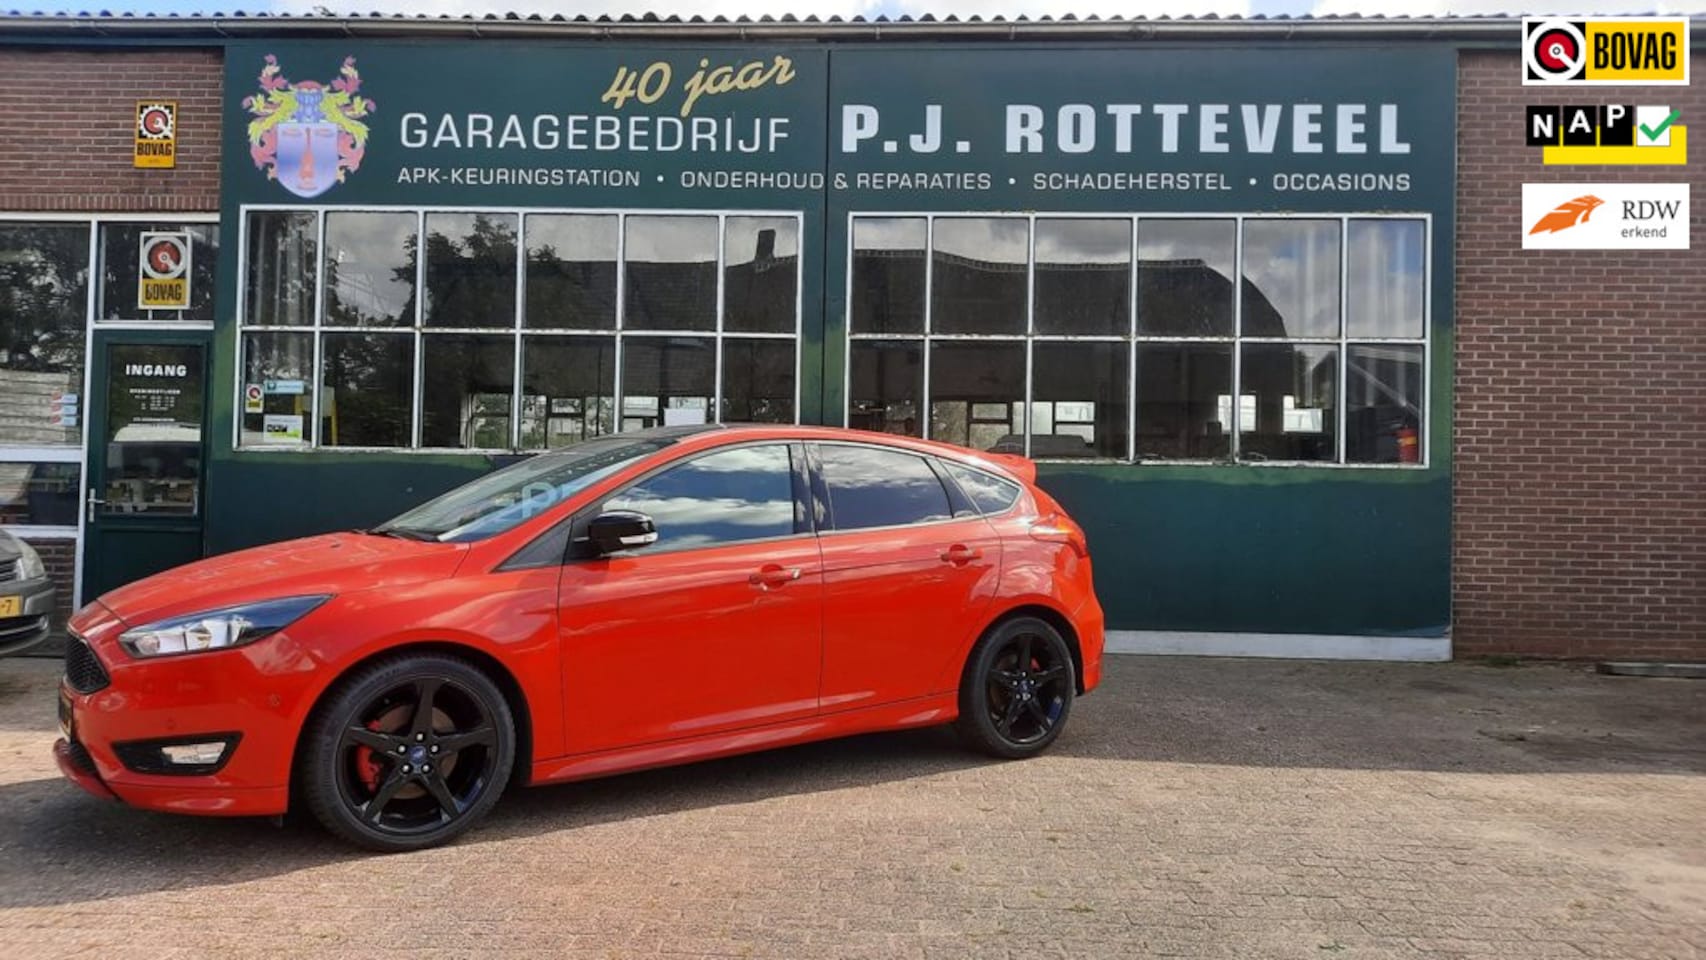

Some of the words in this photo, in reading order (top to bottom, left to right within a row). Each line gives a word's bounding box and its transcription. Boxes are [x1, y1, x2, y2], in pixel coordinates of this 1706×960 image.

[600, 62, 672, 110] 40
[681, 54, 796, 117] jaar
[399, 112, 791, 153] GARAGEBEDRIJF
[841, 104, 971, 153] P.J.
[1005, 104, 1412, 154] ROTTEVEEL
[136, 142, 173, 157] BOVAG
[397, 166, 641, 187] APK-KEURINGSTATION
[680, 170, 825, 189] ONDERHOUD
[833, 173, 849, 190] &
[856, 172, 992, 190] REPARATIES
[1033, 173, 1232, 191] SCHADEHERSTEL
[1273, 173, 1411, 192] OCCASIONS
[145, 283, 183, 301] BOVAG
[125, 364, 187, 377] INGANG
